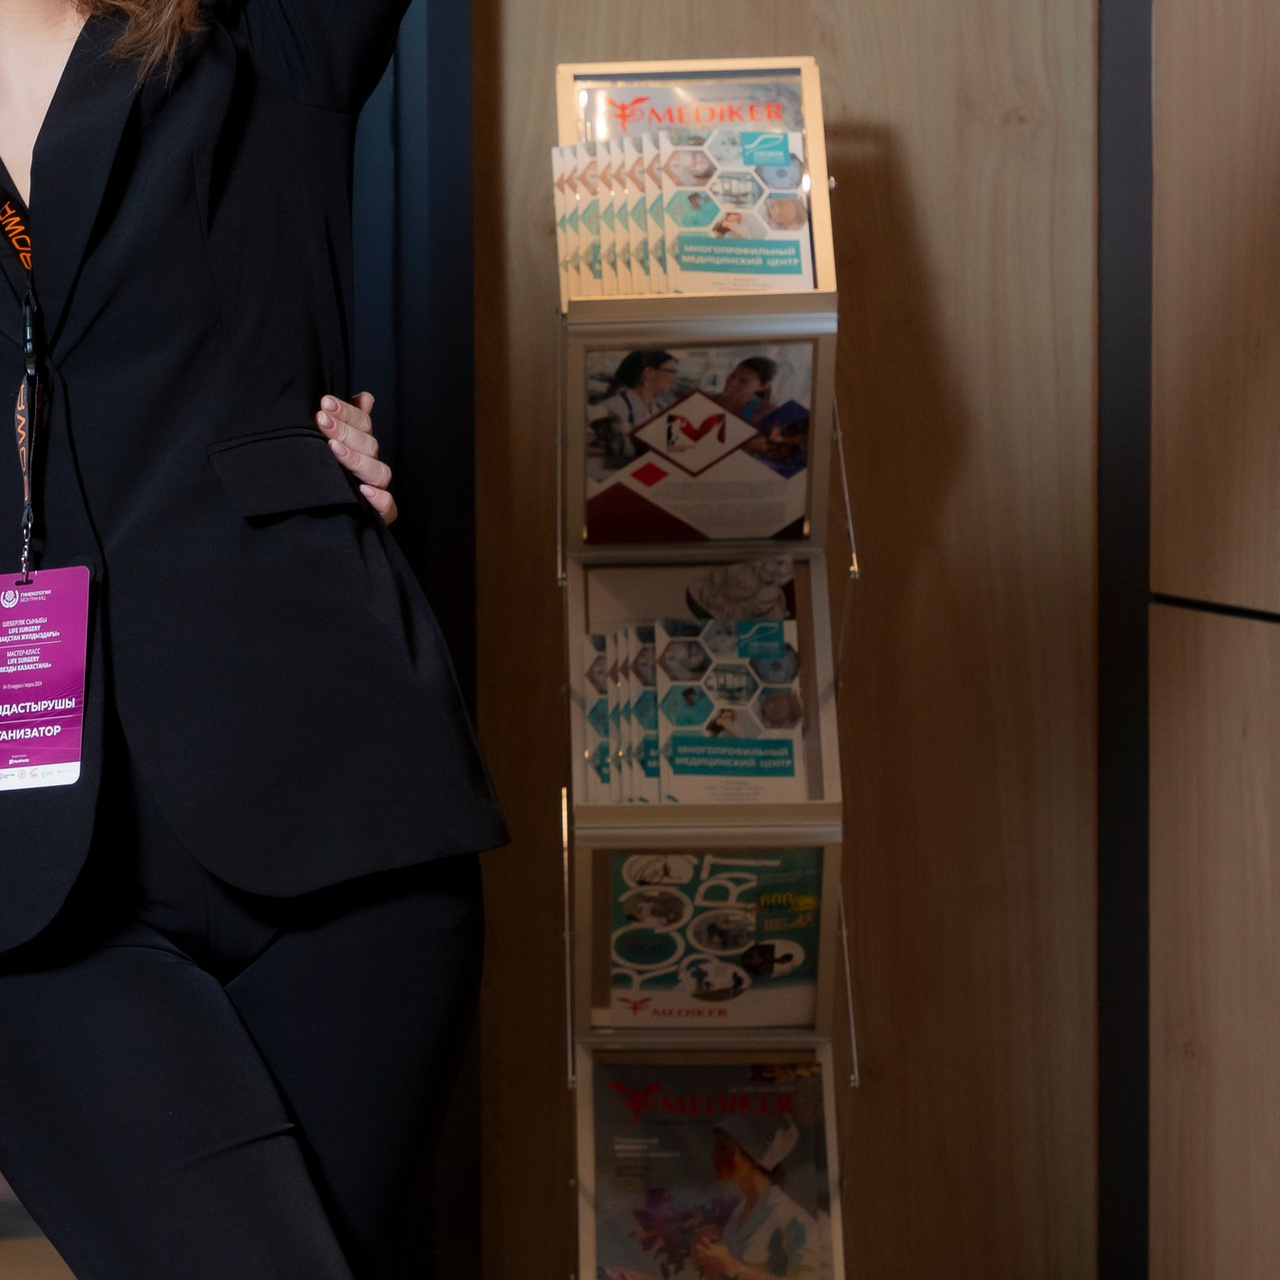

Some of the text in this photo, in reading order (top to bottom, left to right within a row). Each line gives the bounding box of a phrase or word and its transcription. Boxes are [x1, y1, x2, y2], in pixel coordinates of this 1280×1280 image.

[647, 101, 784, 125] MEDIKER
[681, 255, 800, 268] МЕДИЦИНСКИЙ ЦЕНТР
[18, 625, 41, 633] SURGERY
[17, 655, 40, 664] SURGERY
[677, 745, 790, 758] МНОГОПРОФИЛЬНЫЙ
[674, 757, 793, 770] МЕДИЦИНСКИЙ ЦЕНТР
[650, 1007, 729, 1019] MEDIKER
[661, 1093, 797, 1116] MEDIKER
